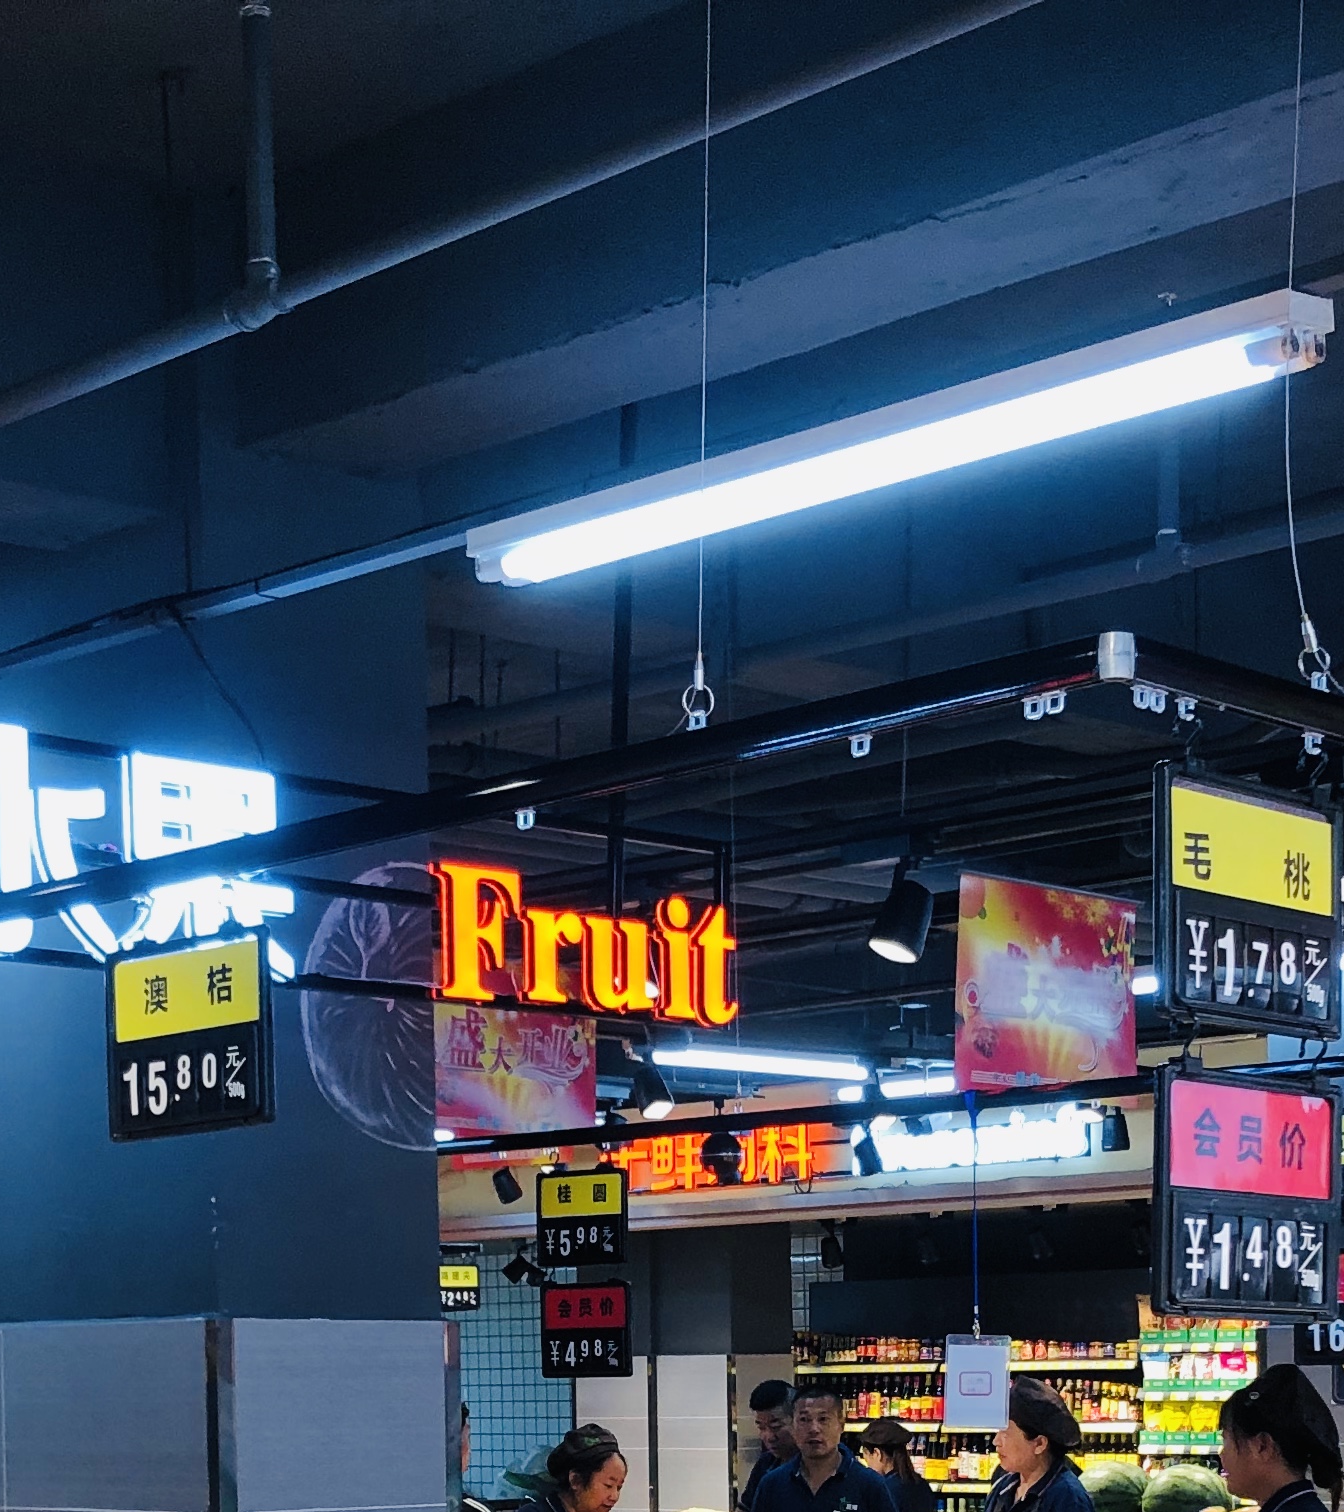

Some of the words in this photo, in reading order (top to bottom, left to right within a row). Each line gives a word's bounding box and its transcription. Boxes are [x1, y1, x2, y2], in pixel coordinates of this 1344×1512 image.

[1182, 831, 1311, 901] 毛桃
[429, 861, 738, 1029] Fruit
[1185, 918, 1297, 998] ¥1.78
[144, 962, 233, 1016] 澳桔
[122, 1052, 218, 1117] 15.80
[1192, 1107, 1307, 1171] 会员价
[545, 1226, 599, 1257] ¥5.98
[1183, 1217, 1294, 1291] ¥1.48
[557, 1295, 615, 1319] 会员价
[550, 1338, 603, 1367] ¥4.98
